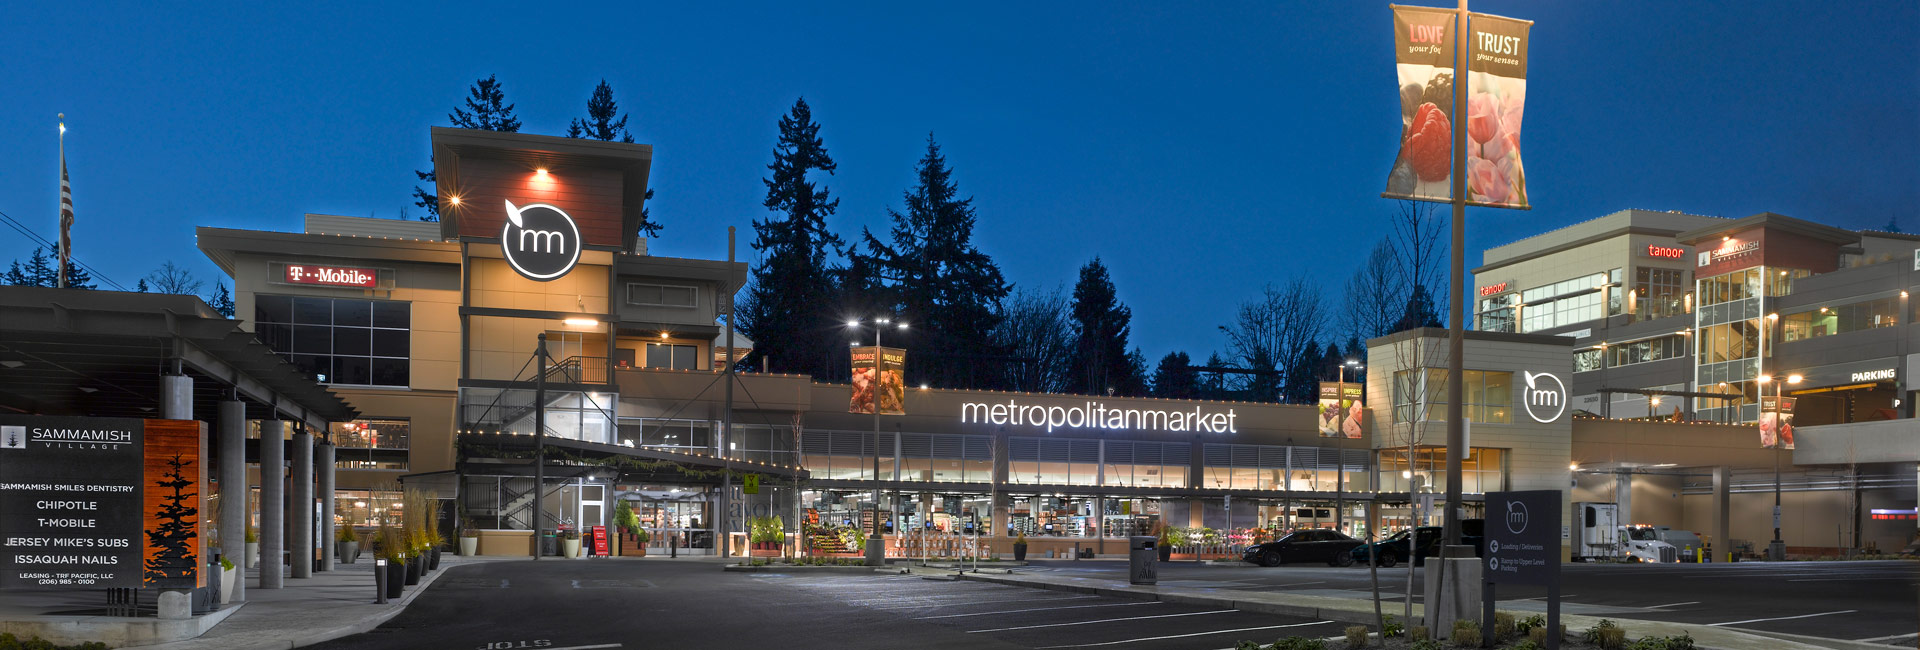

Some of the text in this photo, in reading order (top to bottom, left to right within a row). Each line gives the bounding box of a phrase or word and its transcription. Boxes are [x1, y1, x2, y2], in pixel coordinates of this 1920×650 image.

[1409, 23, 1444, 44] LOVE
[1409, 45, 1429, 54] your
[1476, 31, 1521, 56] TRUST
[1476, 53, 1519, 66] your senses
[1647, 244, 1684, 259] tanoor
[1712, 240, 1760, 257] SAMMAMISH
[1480, 281, 1507, 296] tanoor
[882, 354, 903, 362] INDULGE
[1851, 368, 1895, 382] PARKING
[1894, 399, 1901, 408] P
[961, 399, 1237, 433] metropolitanmarket
[32, 428, 131, 441] SAMMAMISH
[0, 483, 134, 493] SAMMAMISH SMILES DENTISTRY
[36, 500, 98, 510] CHIPOTLE
[37, 518, 96, 528] T-MOBILE
[4, 537, 129, 547] JERSEY MIKE'S SUBS
[15, 555, 118, 565] ISSAQUAH NAILS
